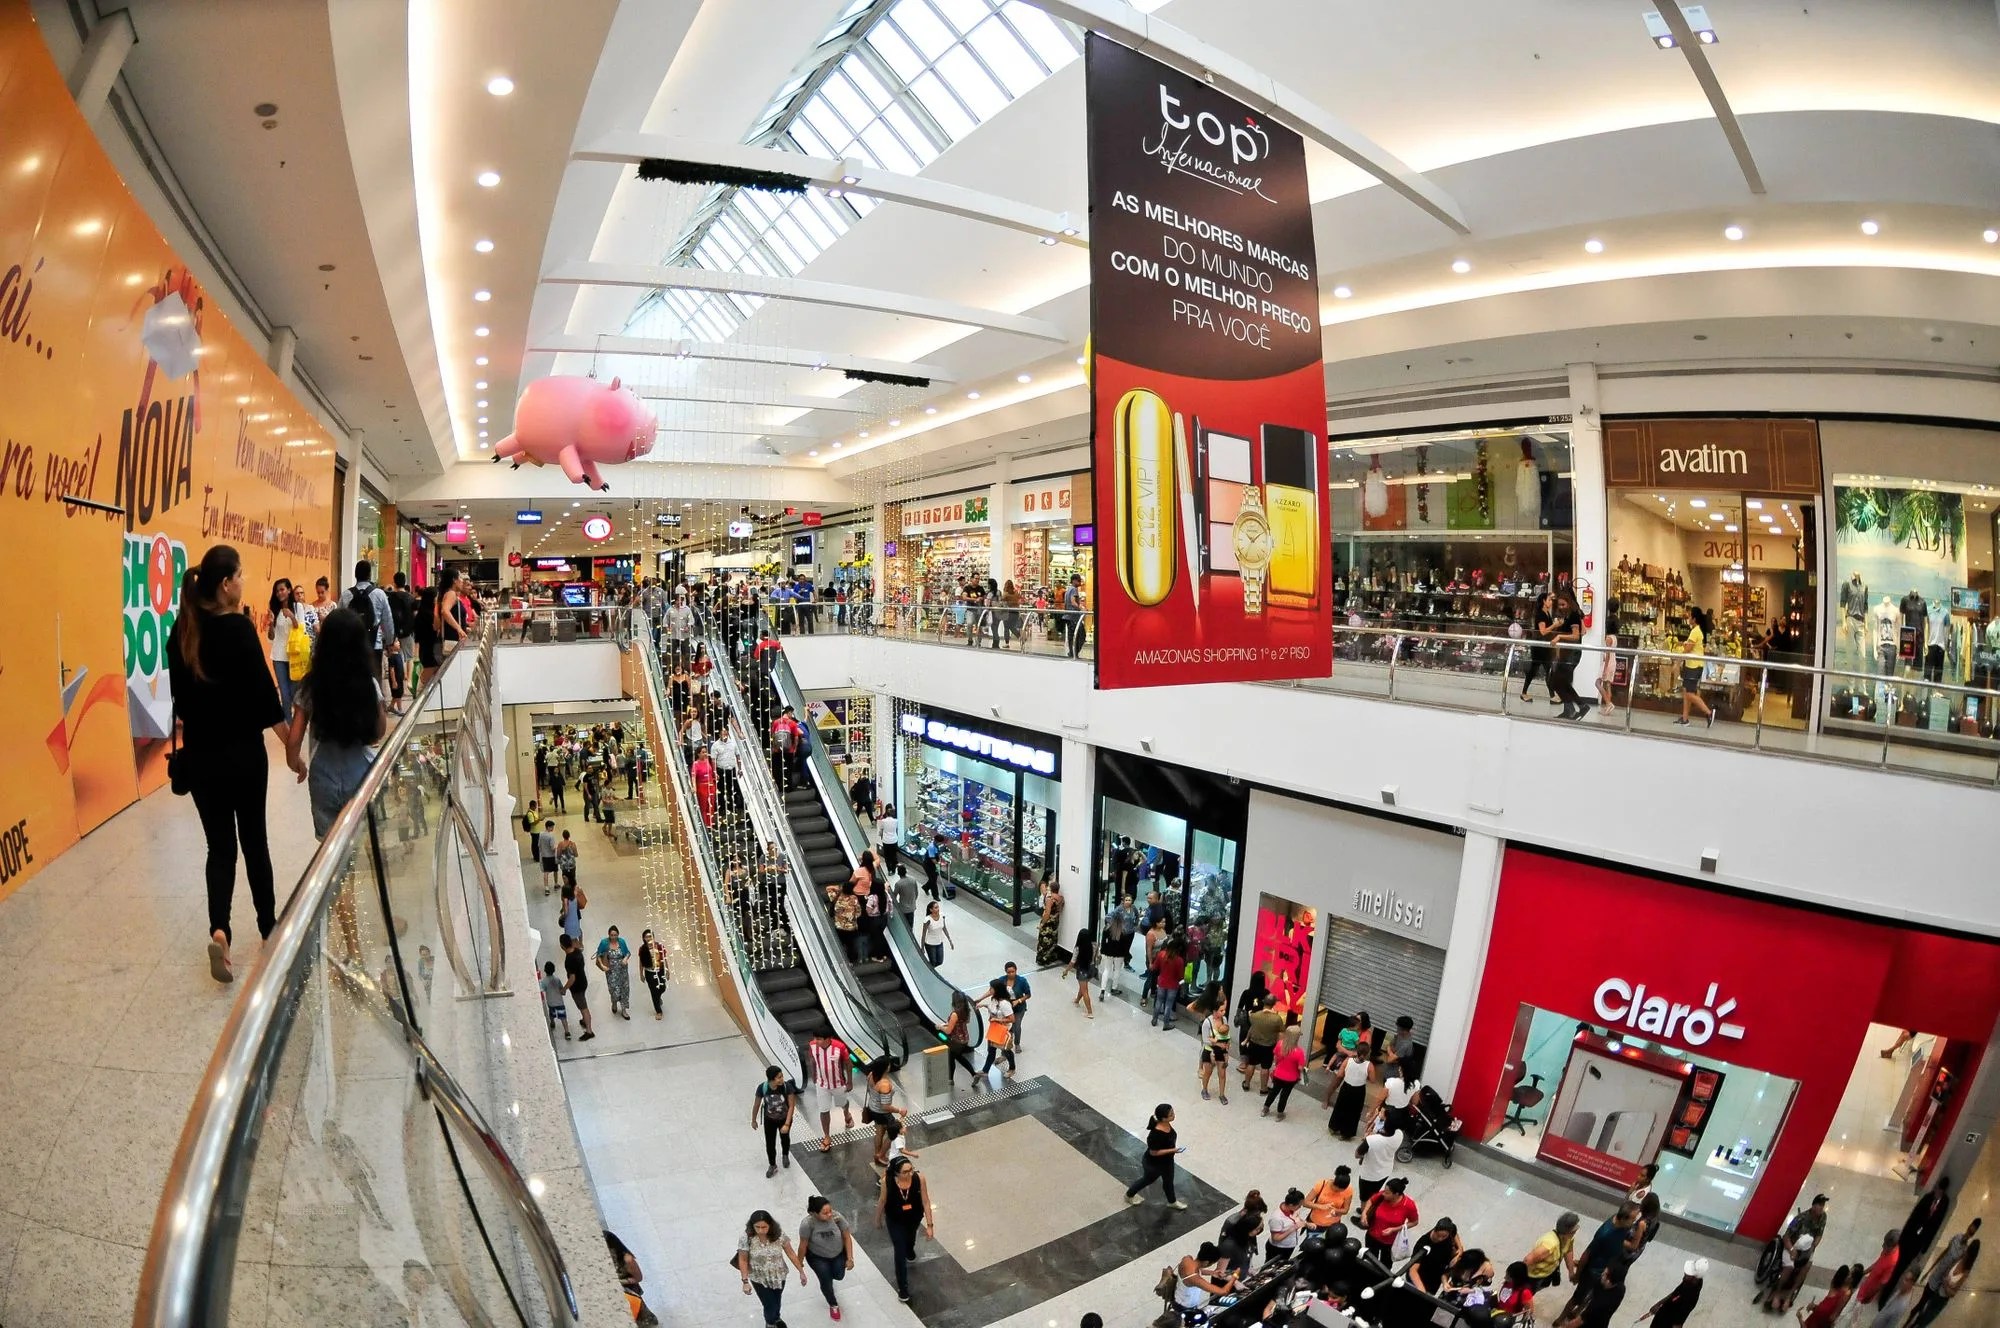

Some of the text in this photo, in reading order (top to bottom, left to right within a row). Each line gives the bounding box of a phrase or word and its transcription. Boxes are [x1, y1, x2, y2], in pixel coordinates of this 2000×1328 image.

[1160, 84, 1258, 165] top
[1143, 122, 1278, 204] Internacional
[1112, 190, 1309, 281] AS MELHORES MARCAS
[1163, 235, 1273, 294] DO MUNDO
[1111, 251, 1311, 334] COM O MELHOR PREÇO
[1173, 299, 1272, 351] PRA VOCÊ
[114, 395, 195, 533] NOVA
[236, 407, 256, 473] Vem
[1660, 444, 1748, 474] avatim
[1137, 467, 1153, 499] VIP
[965, 508, 988, 523] DOPE
[1134, 649, 1201, 665] AMAZONAS
[1203, 647, 1257, 663] SHOPPING
[1271, 649, 1277, 660] e
[1289, 646, 1311, 660] PISO
[1360, 888, 1424, 929] melissa
[1593, 977, 1715, 1046] Claro
